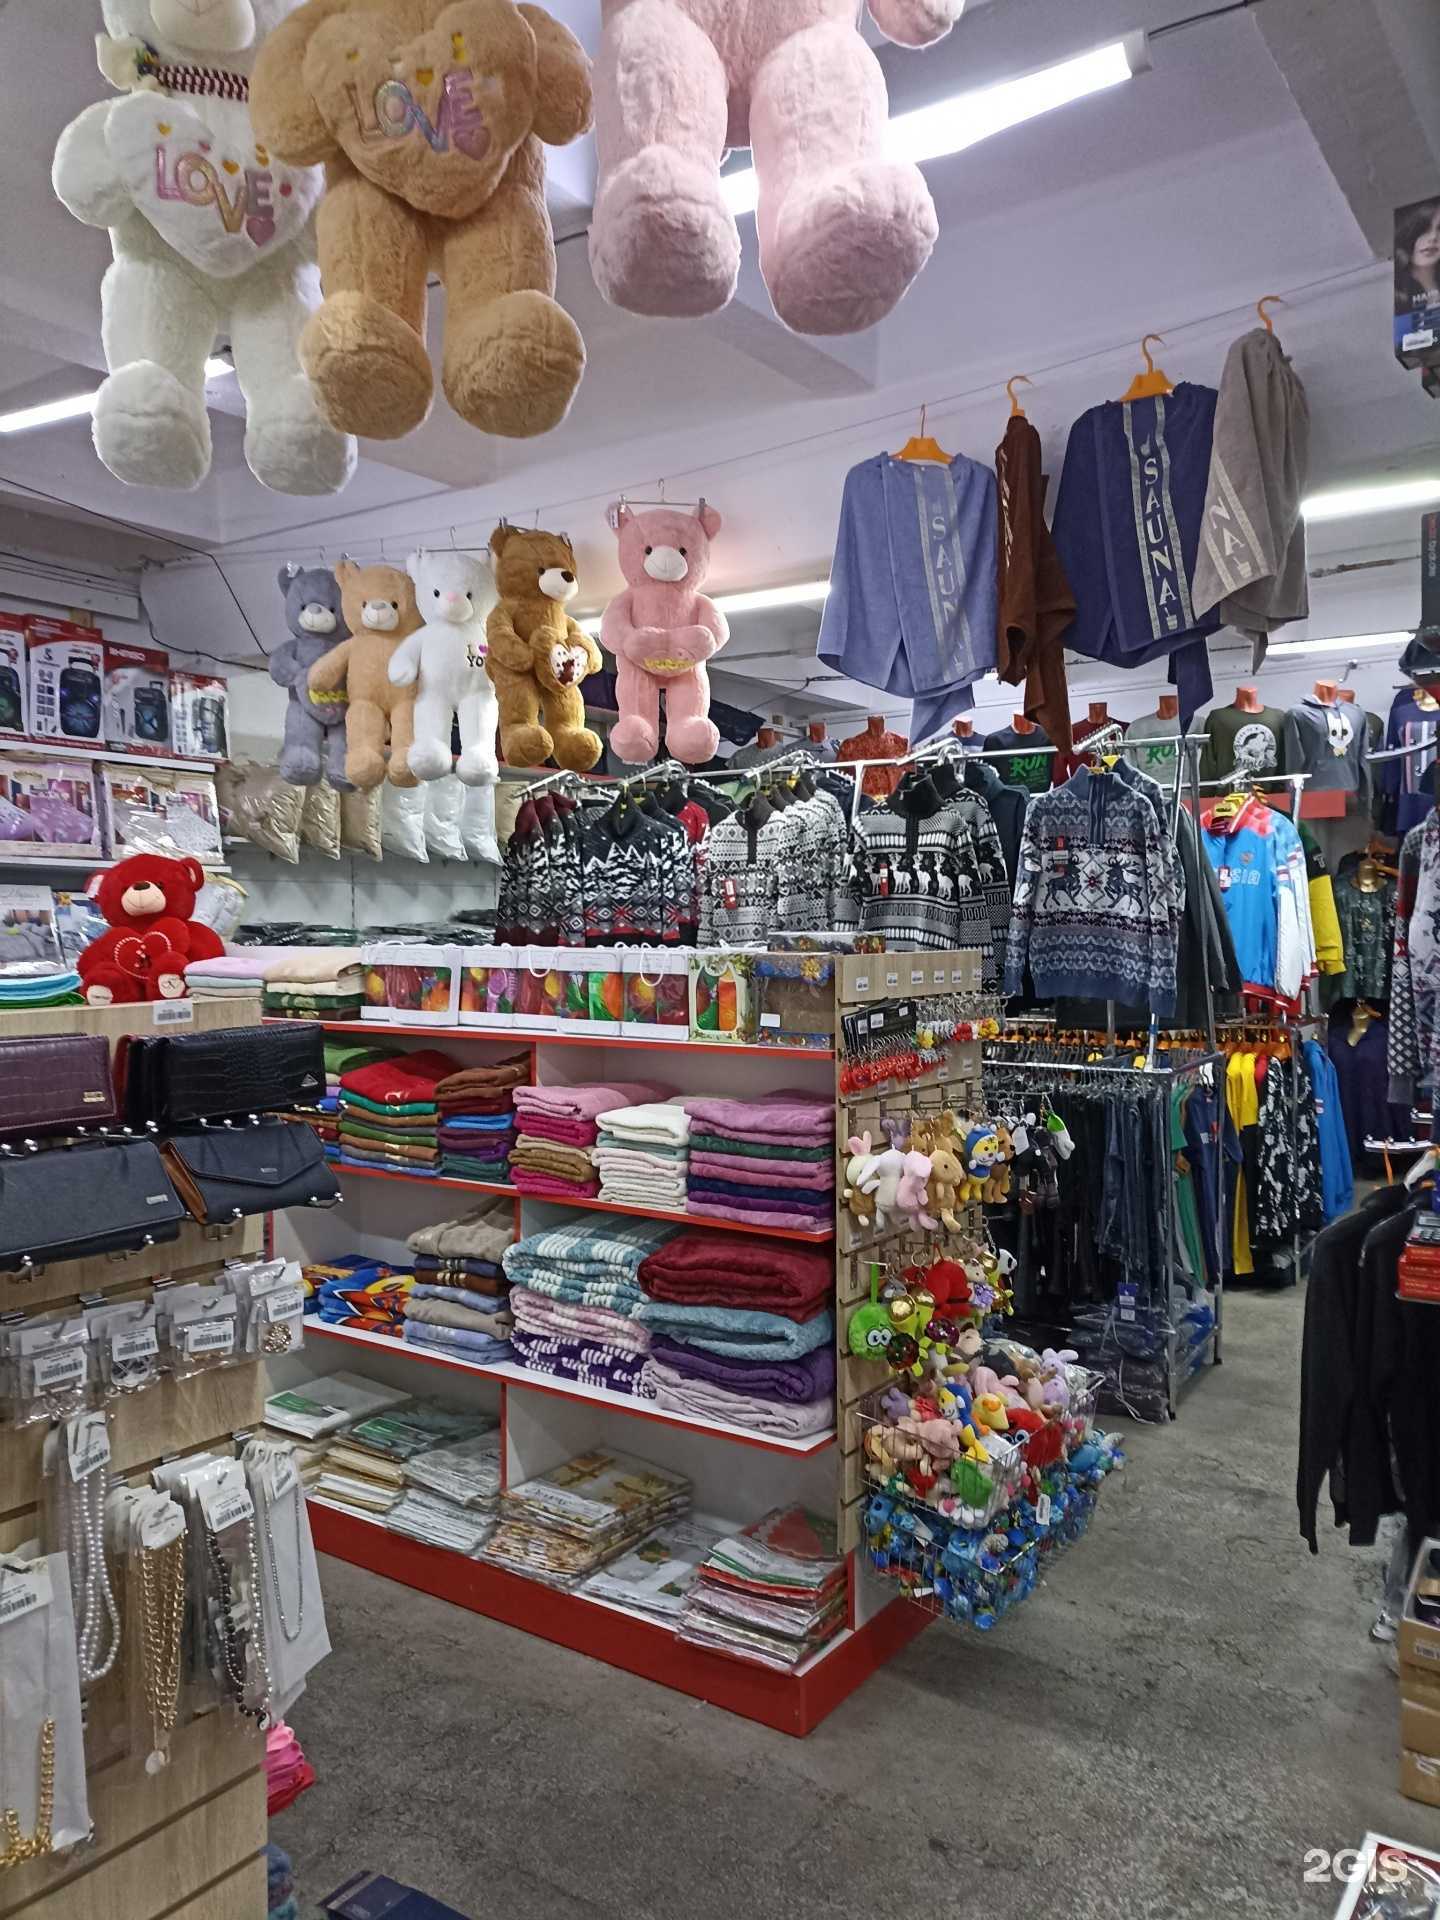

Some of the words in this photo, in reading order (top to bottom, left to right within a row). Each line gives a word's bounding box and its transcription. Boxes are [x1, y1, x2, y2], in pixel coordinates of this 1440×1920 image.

[352, 70, 488, 154] LOVE
[154, 142, 276, 235] LOVE
[1142, 457, 1178, 607] SAUNA
[466, 655, 487, 668] YO
[1009, 754, 1049, 777] RUN
